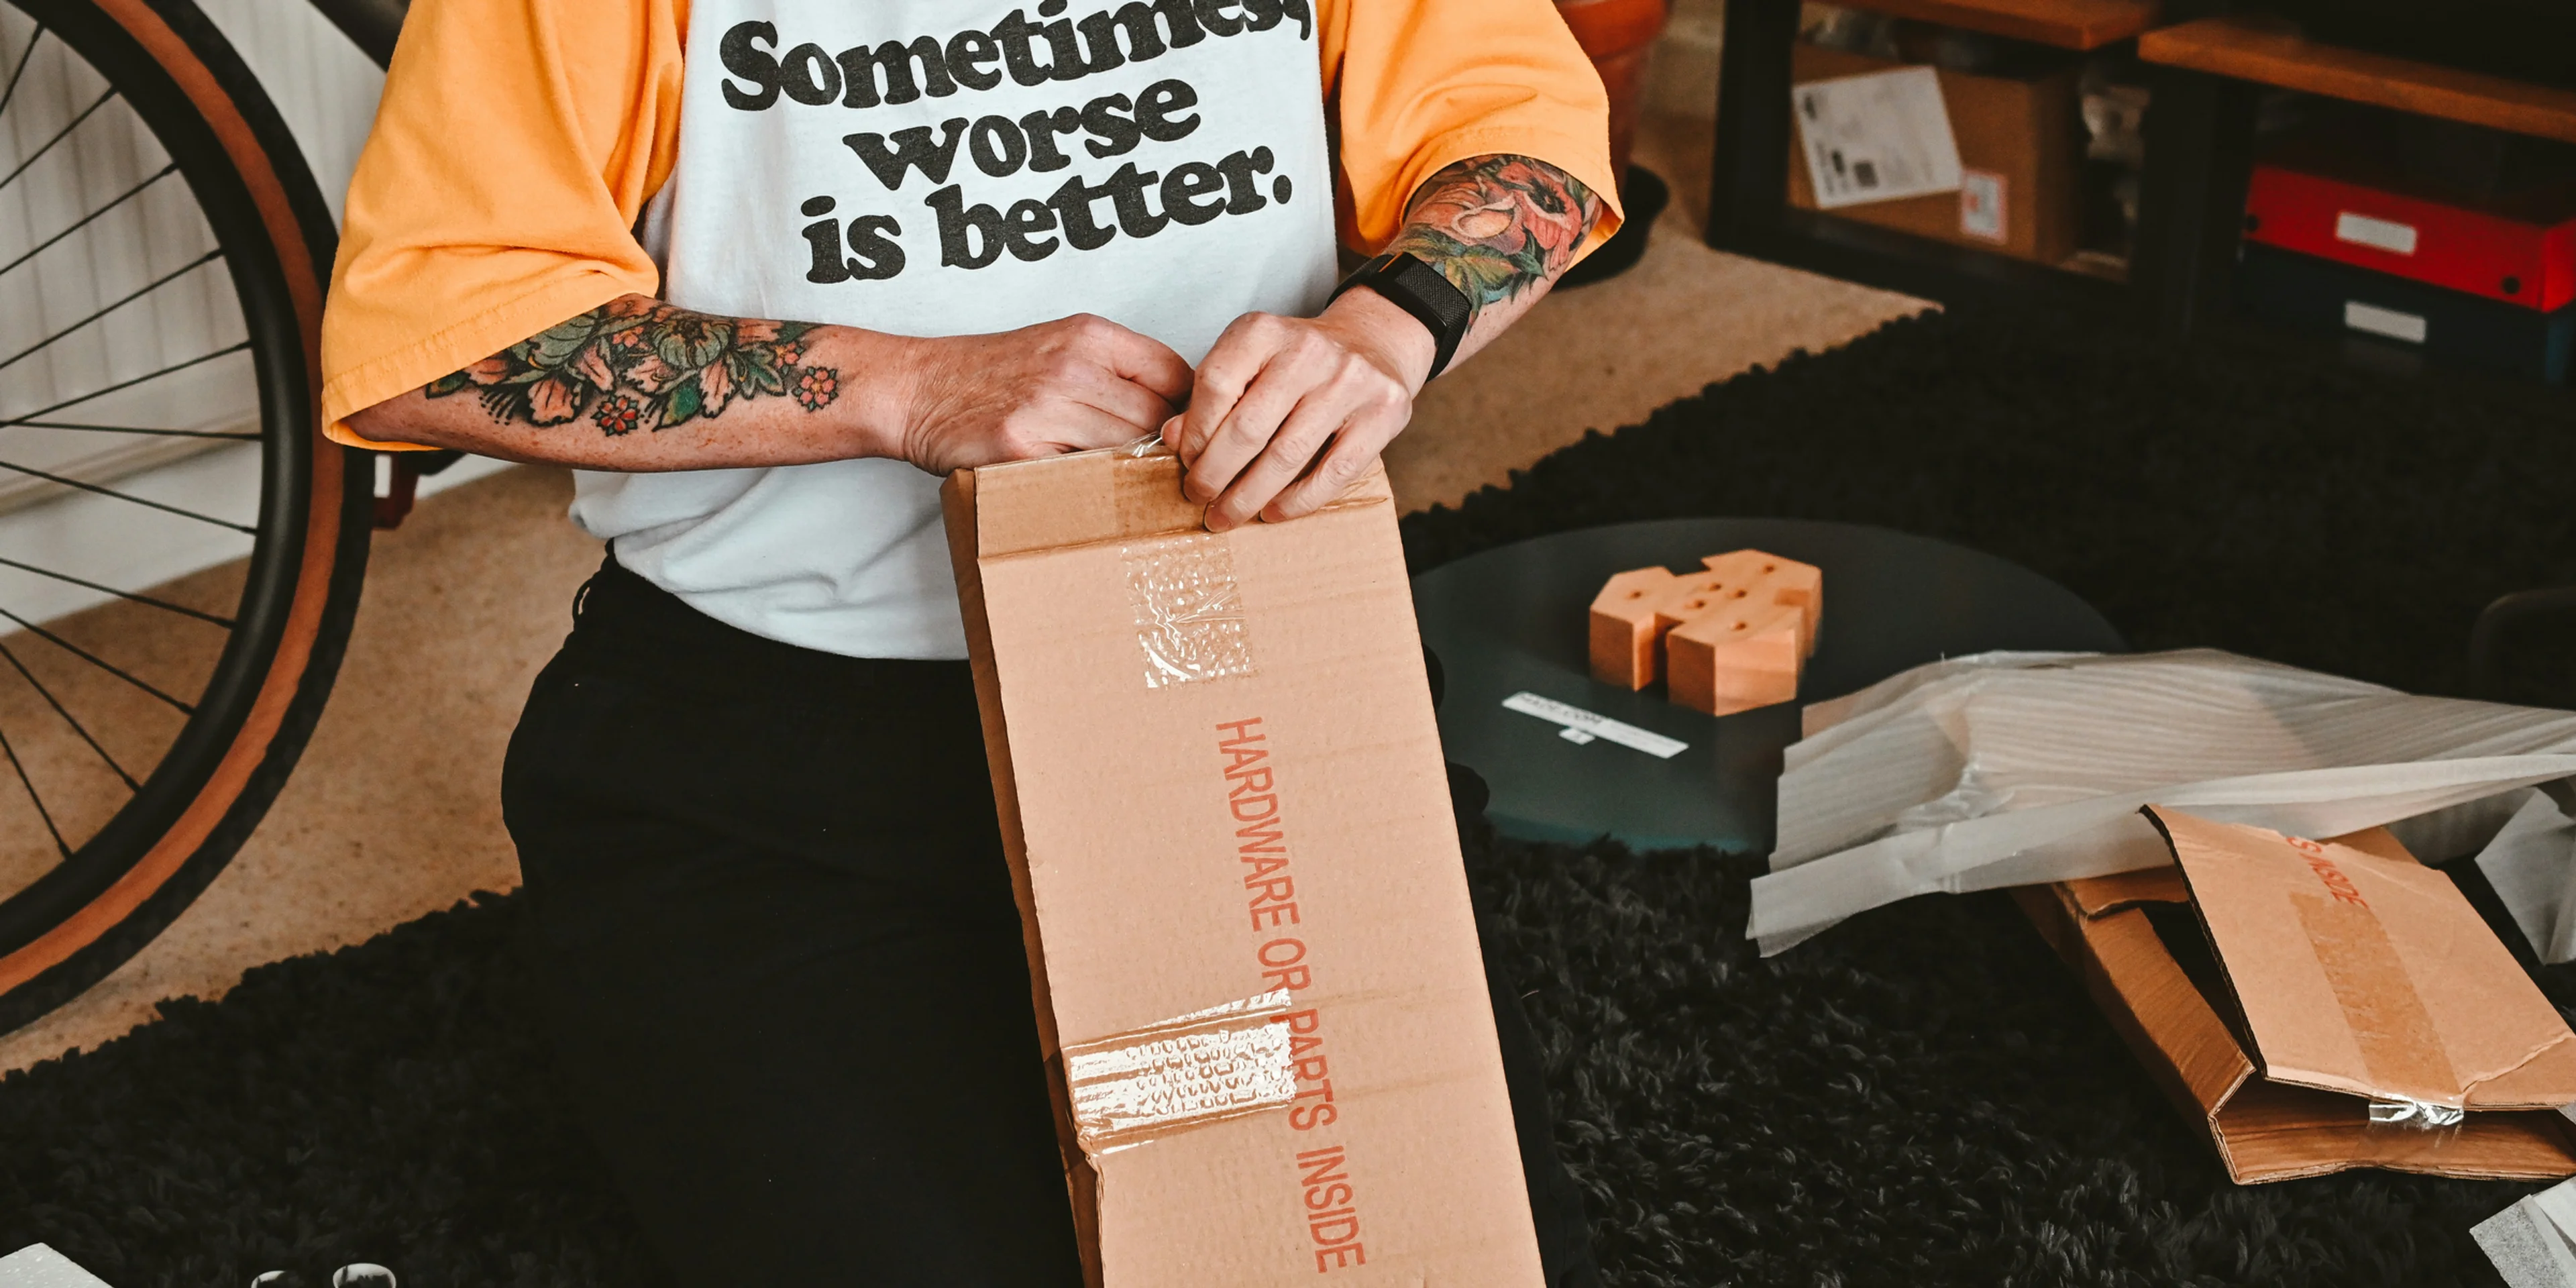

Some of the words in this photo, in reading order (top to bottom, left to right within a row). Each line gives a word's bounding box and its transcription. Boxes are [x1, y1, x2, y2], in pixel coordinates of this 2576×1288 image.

[719, 0, 1311, 111] Sometimes,
[843, 78, 1201, 191] worse
[800, 195, 906, 284] is
[924, 146, 1292, 270] better.
[1216, 717, 1300, 932] HARDWARE
[1257, 938, 1311, 994] OR
[1269, 1008, 1338, 1130] PARTS
[1297, 1145, 1366, 1273] INSIDE
